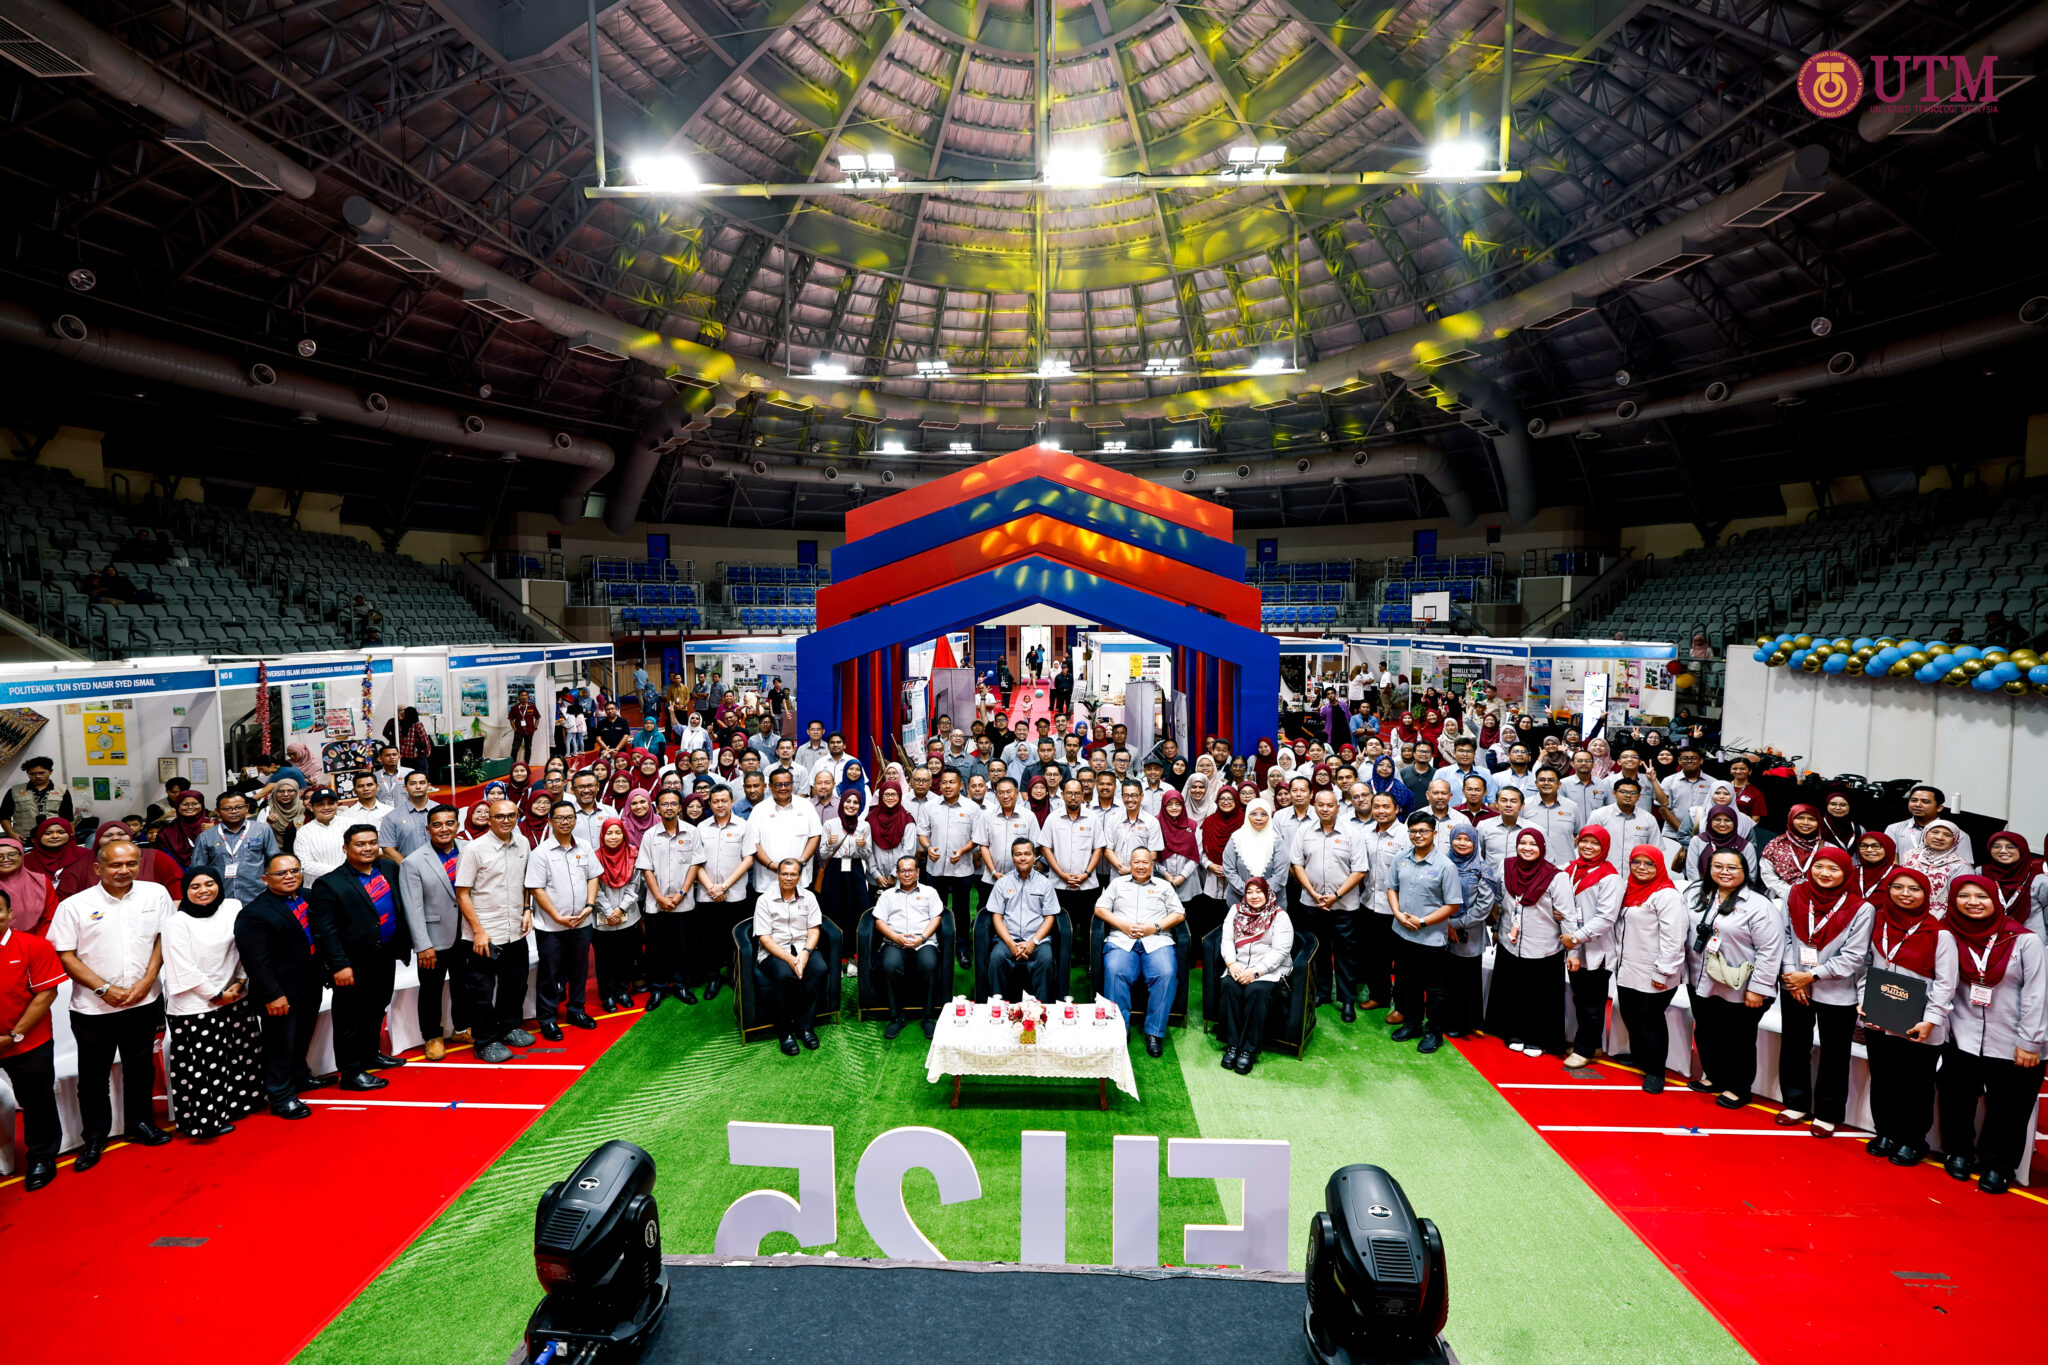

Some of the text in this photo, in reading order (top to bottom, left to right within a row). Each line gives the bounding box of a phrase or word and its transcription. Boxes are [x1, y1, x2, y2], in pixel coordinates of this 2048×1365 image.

[286, 667, 300, 676] ISLAM
[301, 665, 333, 675] ANTARABANGSA
[334, 664, 353, 673] MALAYSIA
[9, 678, 156, 696] POLITEKNIK TUN SYED NASIR SYED ISMAIL
